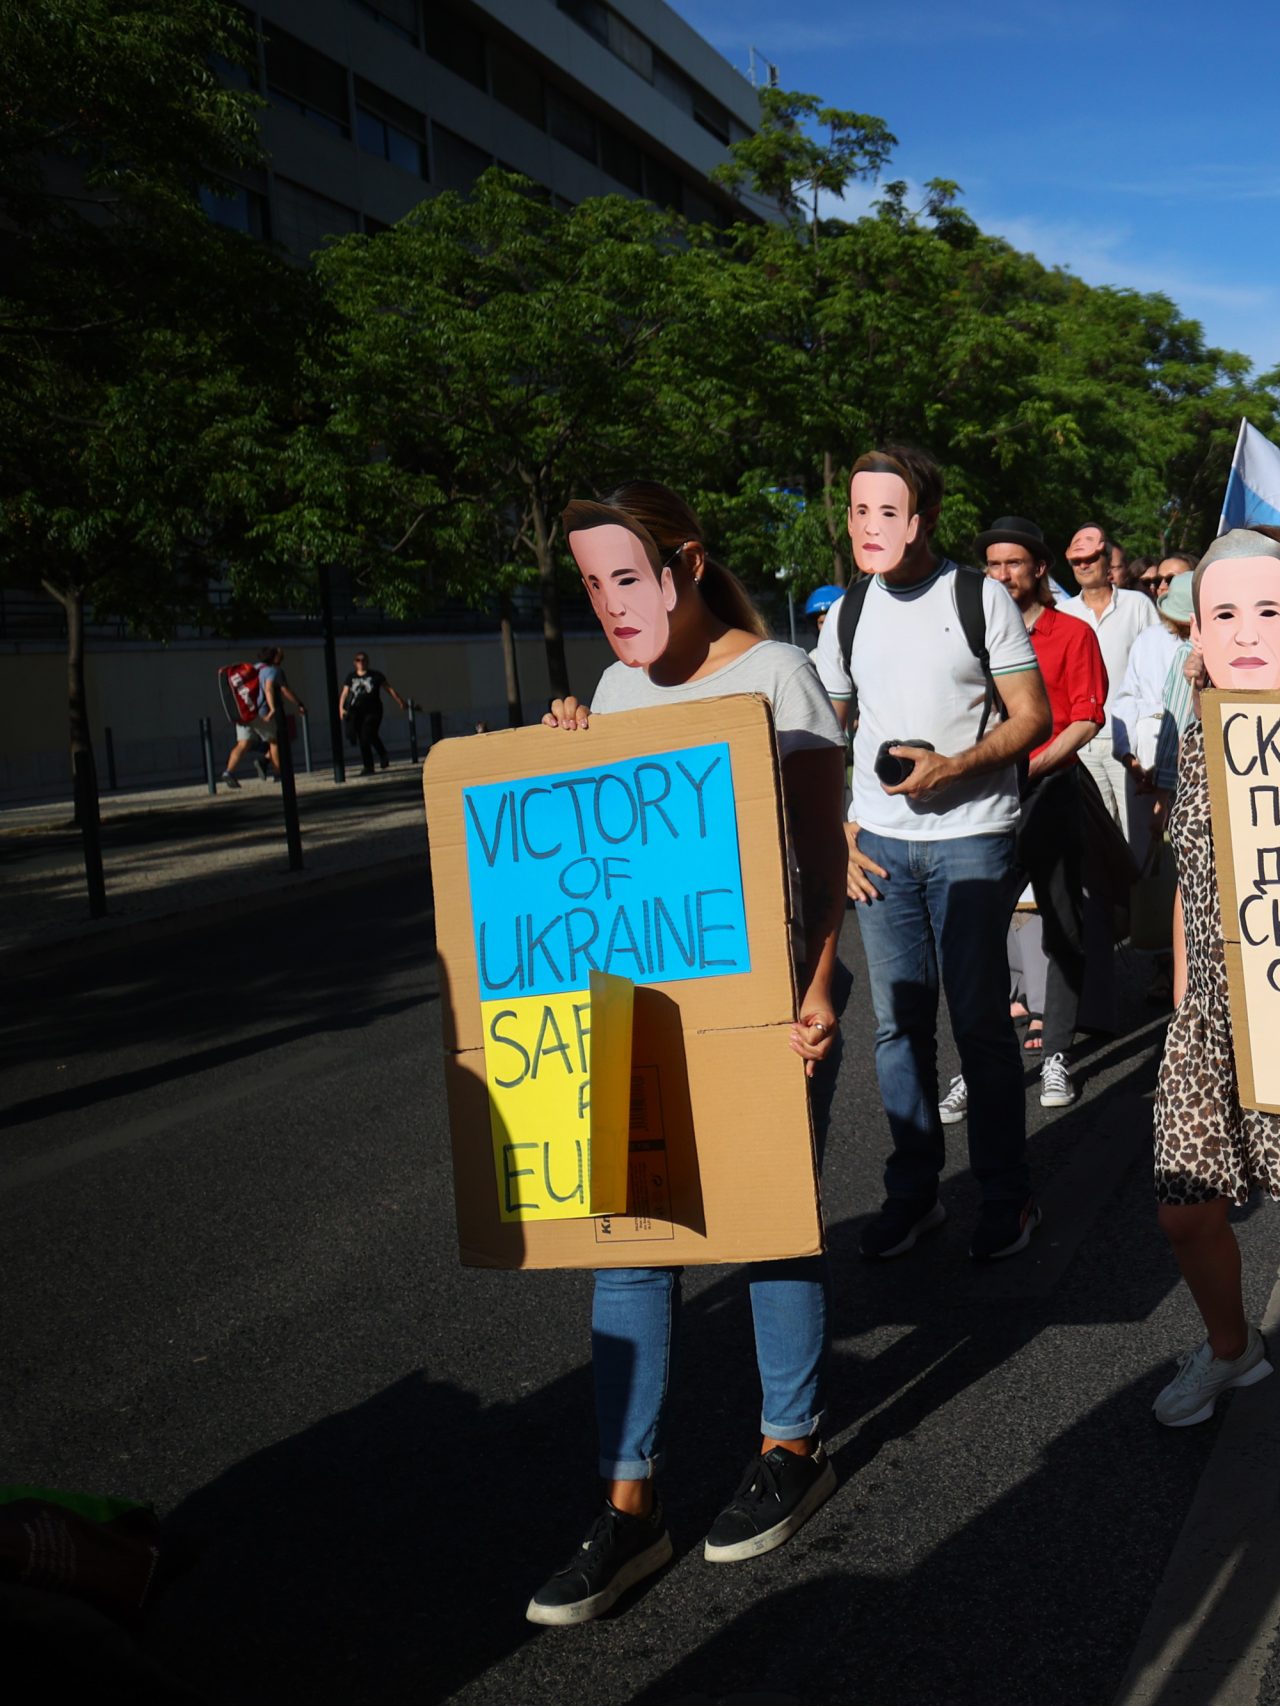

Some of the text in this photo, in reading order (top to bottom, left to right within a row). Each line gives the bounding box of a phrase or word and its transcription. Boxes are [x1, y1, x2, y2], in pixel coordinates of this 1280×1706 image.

[465, 756, 721, 867] VICTORY
[558, 857, 632, 900] OF
[480, 888, 737, 991] UKRAINE
[490, 1002, 591, 1088] SAF
[502, 1138, 591, 1213] EU
